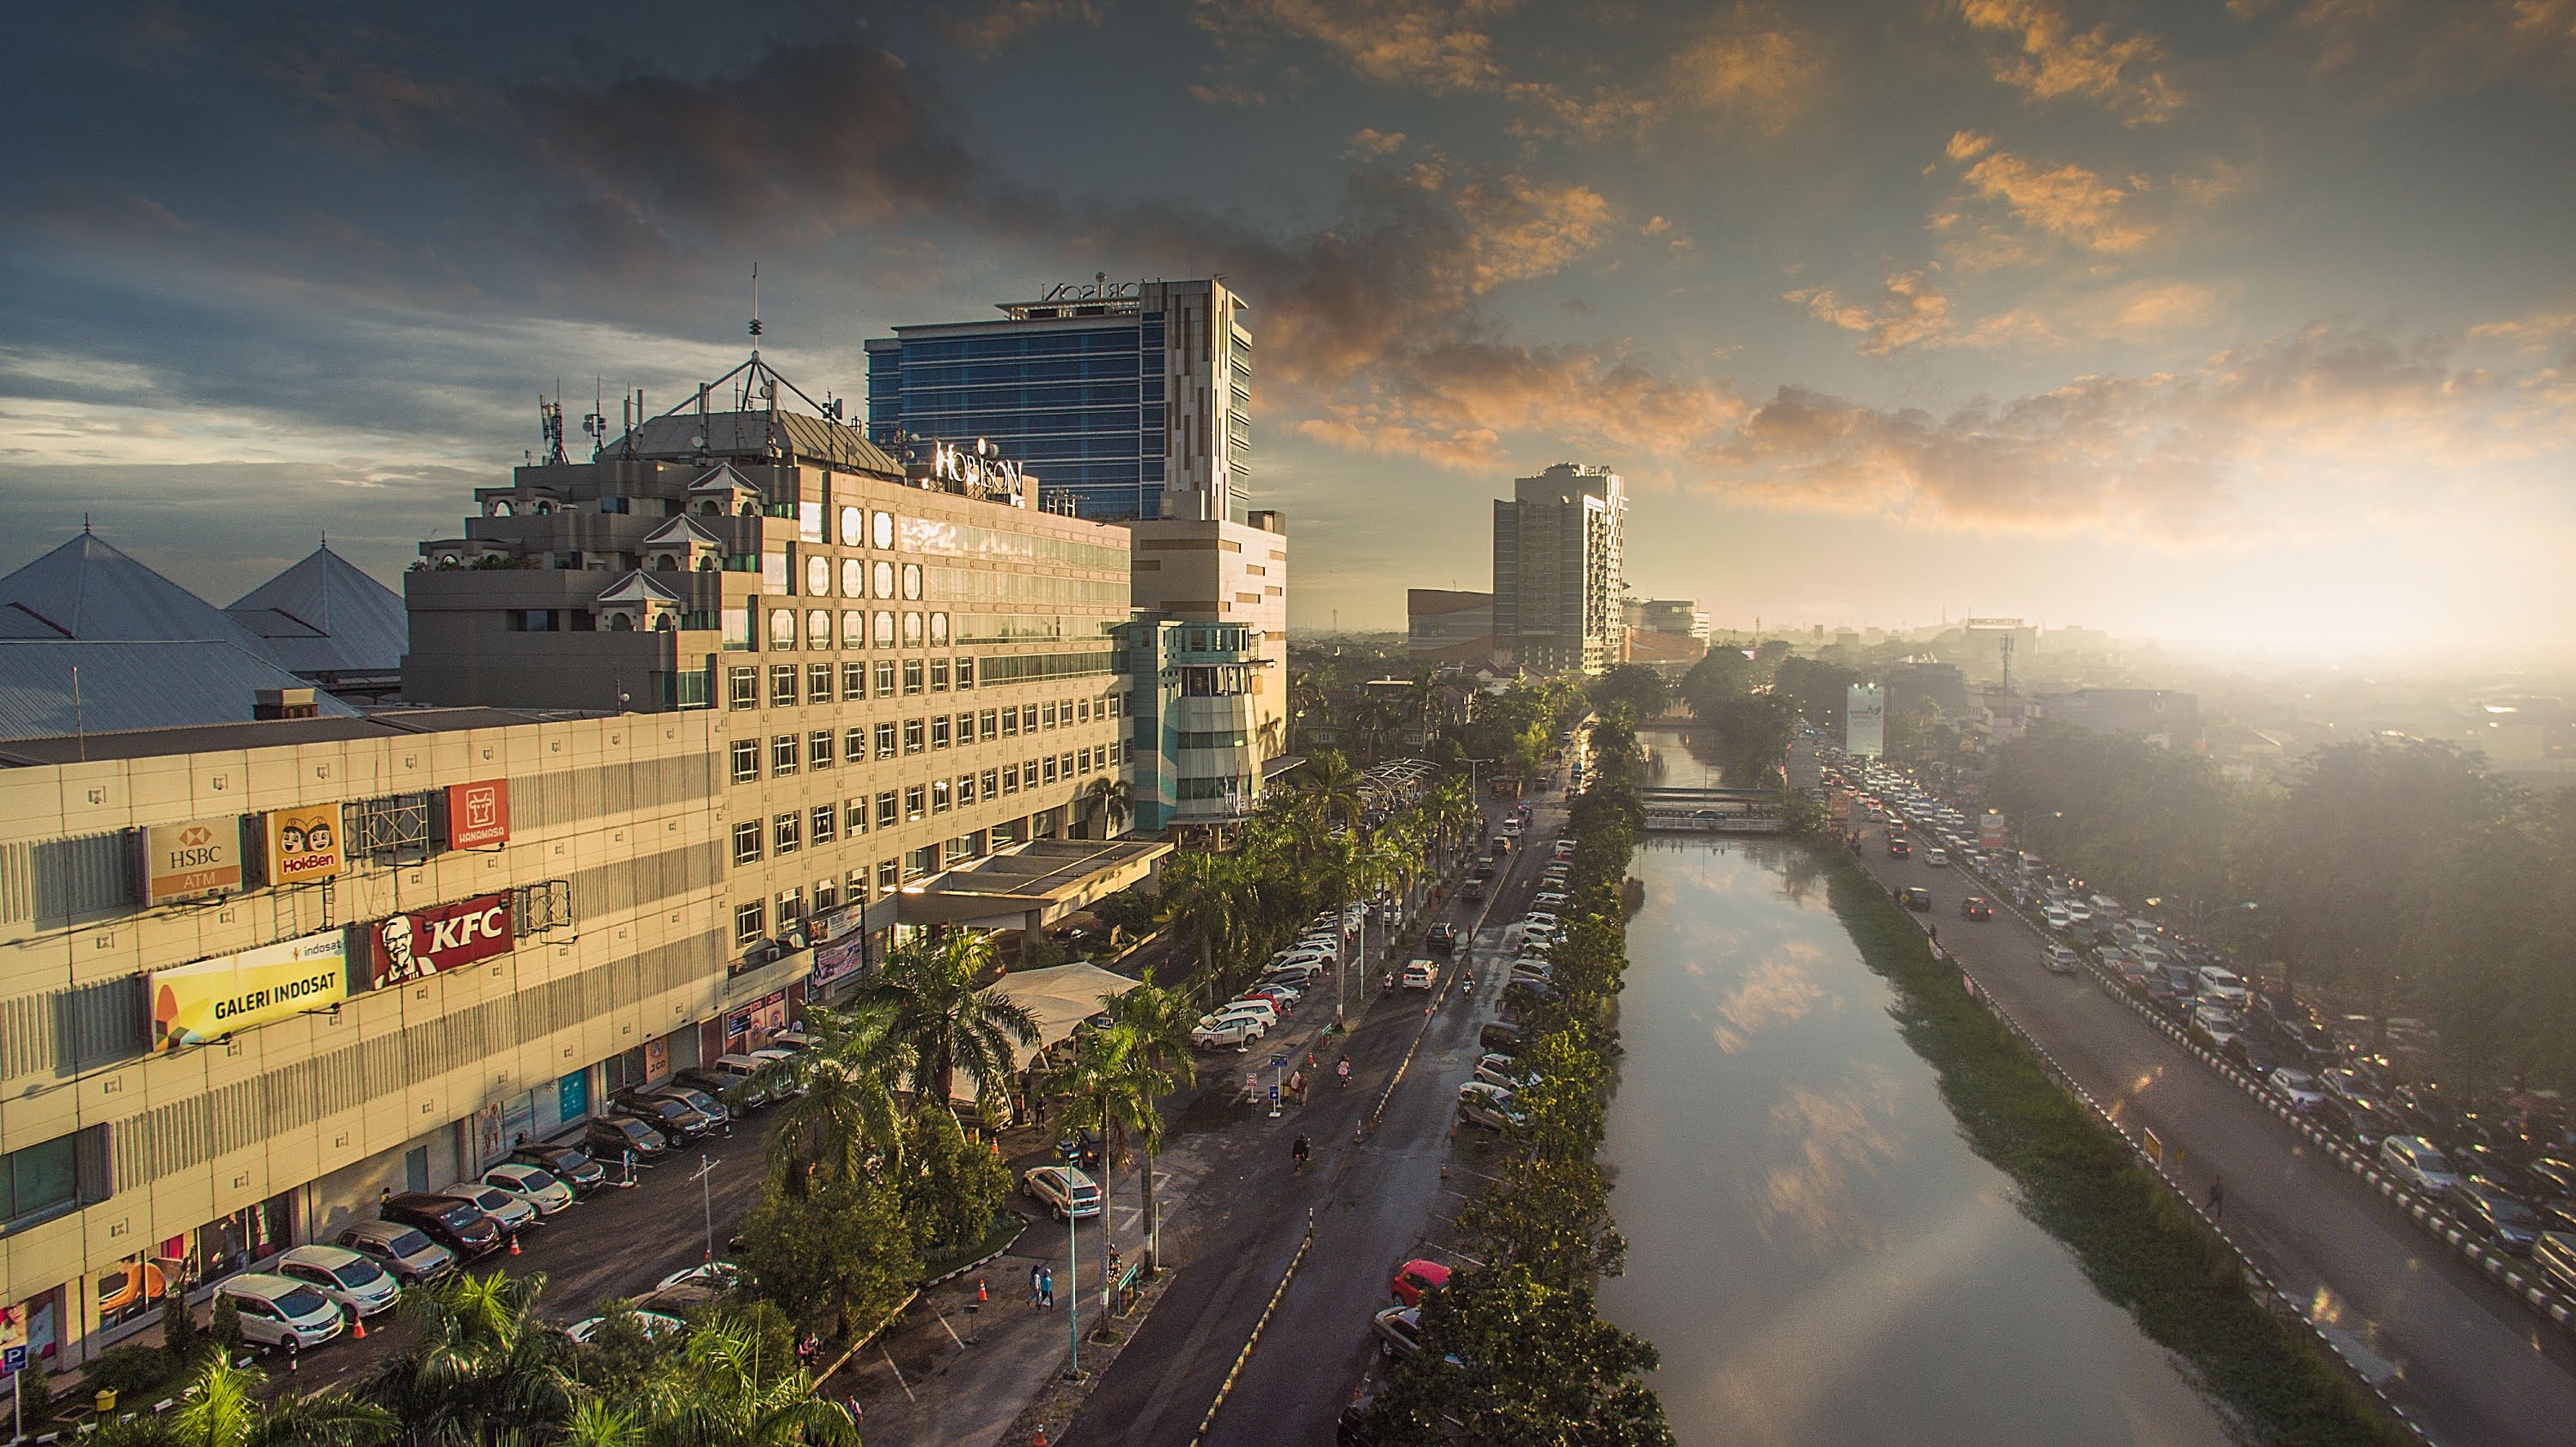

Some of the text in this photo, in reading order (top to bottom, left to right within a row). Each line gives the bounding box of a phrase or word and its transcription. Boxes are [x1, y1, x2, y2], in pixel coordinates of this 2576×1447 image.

[936, 438, 1023, 494] HORISON
[459, 826, 504, 843] HANAMASA
[171, 846, 222, 869] HSBC
[283, 854, 334, 874] HokBen
[183, 872, 216, 890] ATM
[428, 906, 503, 954] KFC
[304, 941, 343, 957] indosat
[216, 972, 336, 1020] GALERI INDOSAT
[8, 1349, 21, 1363] P
